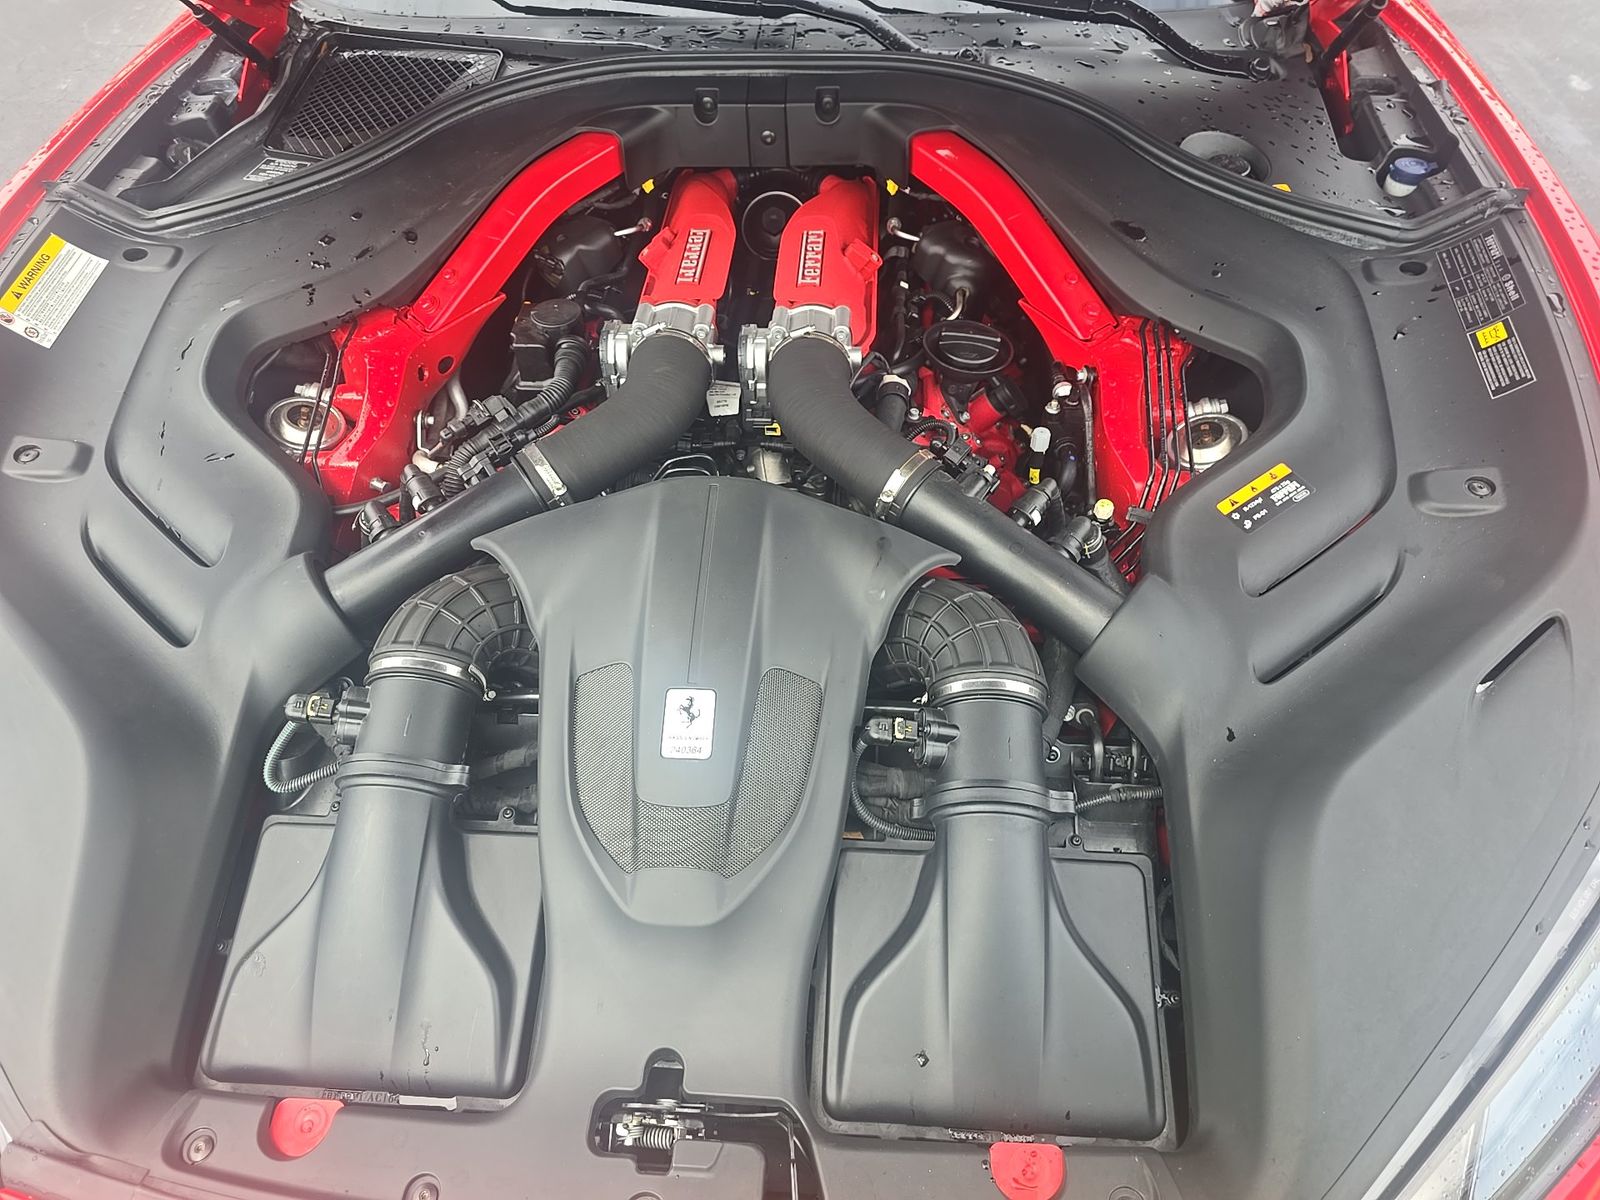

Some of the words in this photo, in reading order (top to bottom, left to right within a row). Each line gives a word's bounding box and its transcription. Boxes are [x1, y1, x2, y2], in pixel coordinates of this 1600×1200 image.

[17, 253, 51, 290] WARNING
[677, 229, 711, 285] Ferrari
[798, 230, 825, 287] Ferrari
[1504, 280, 1520, 302] Shell
